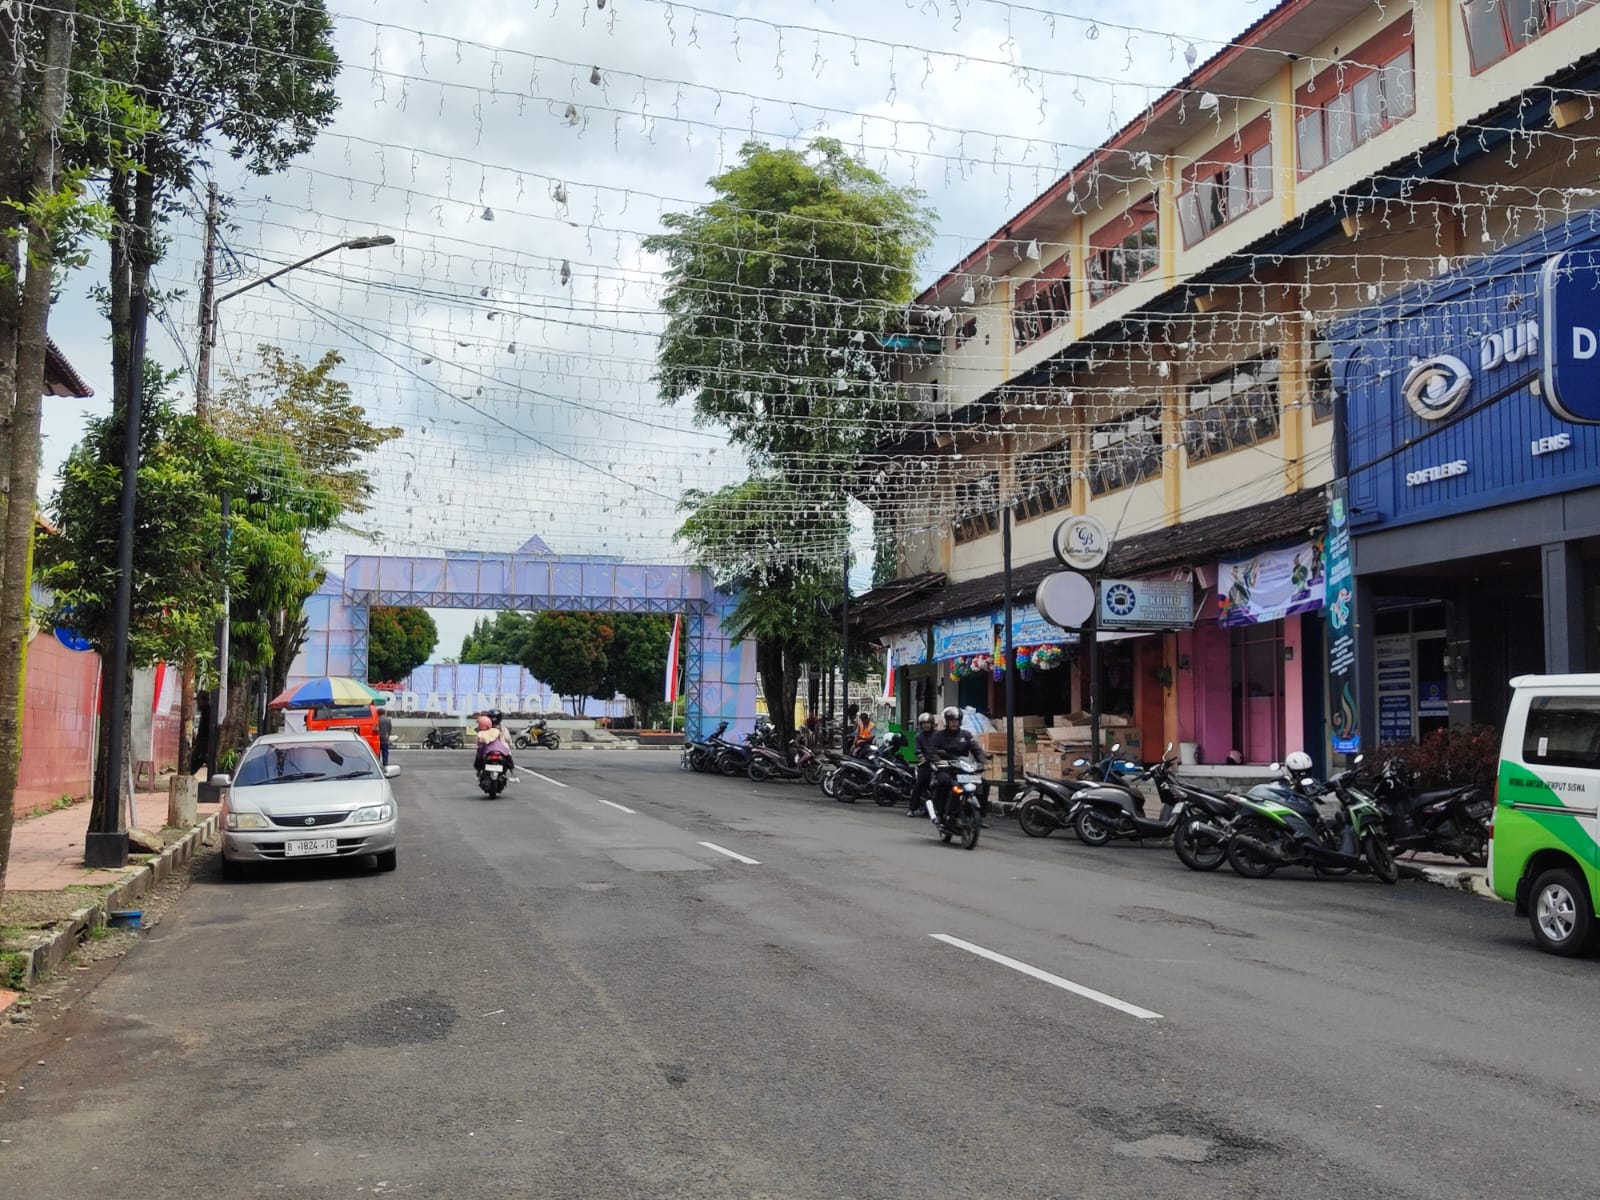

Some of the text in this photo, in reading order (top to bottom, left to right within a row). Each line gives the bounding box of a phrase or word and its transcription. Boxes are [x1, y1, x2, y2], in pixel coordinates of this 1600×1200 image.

[1572, 326, 1600, 360] D
[1531, 433, 1571, 456] LENS
[1406, 459, 1468, 487] SOFTLENS
[1567, 783, 1586, 793] SISWA
[287, 842, 293, 852] B
